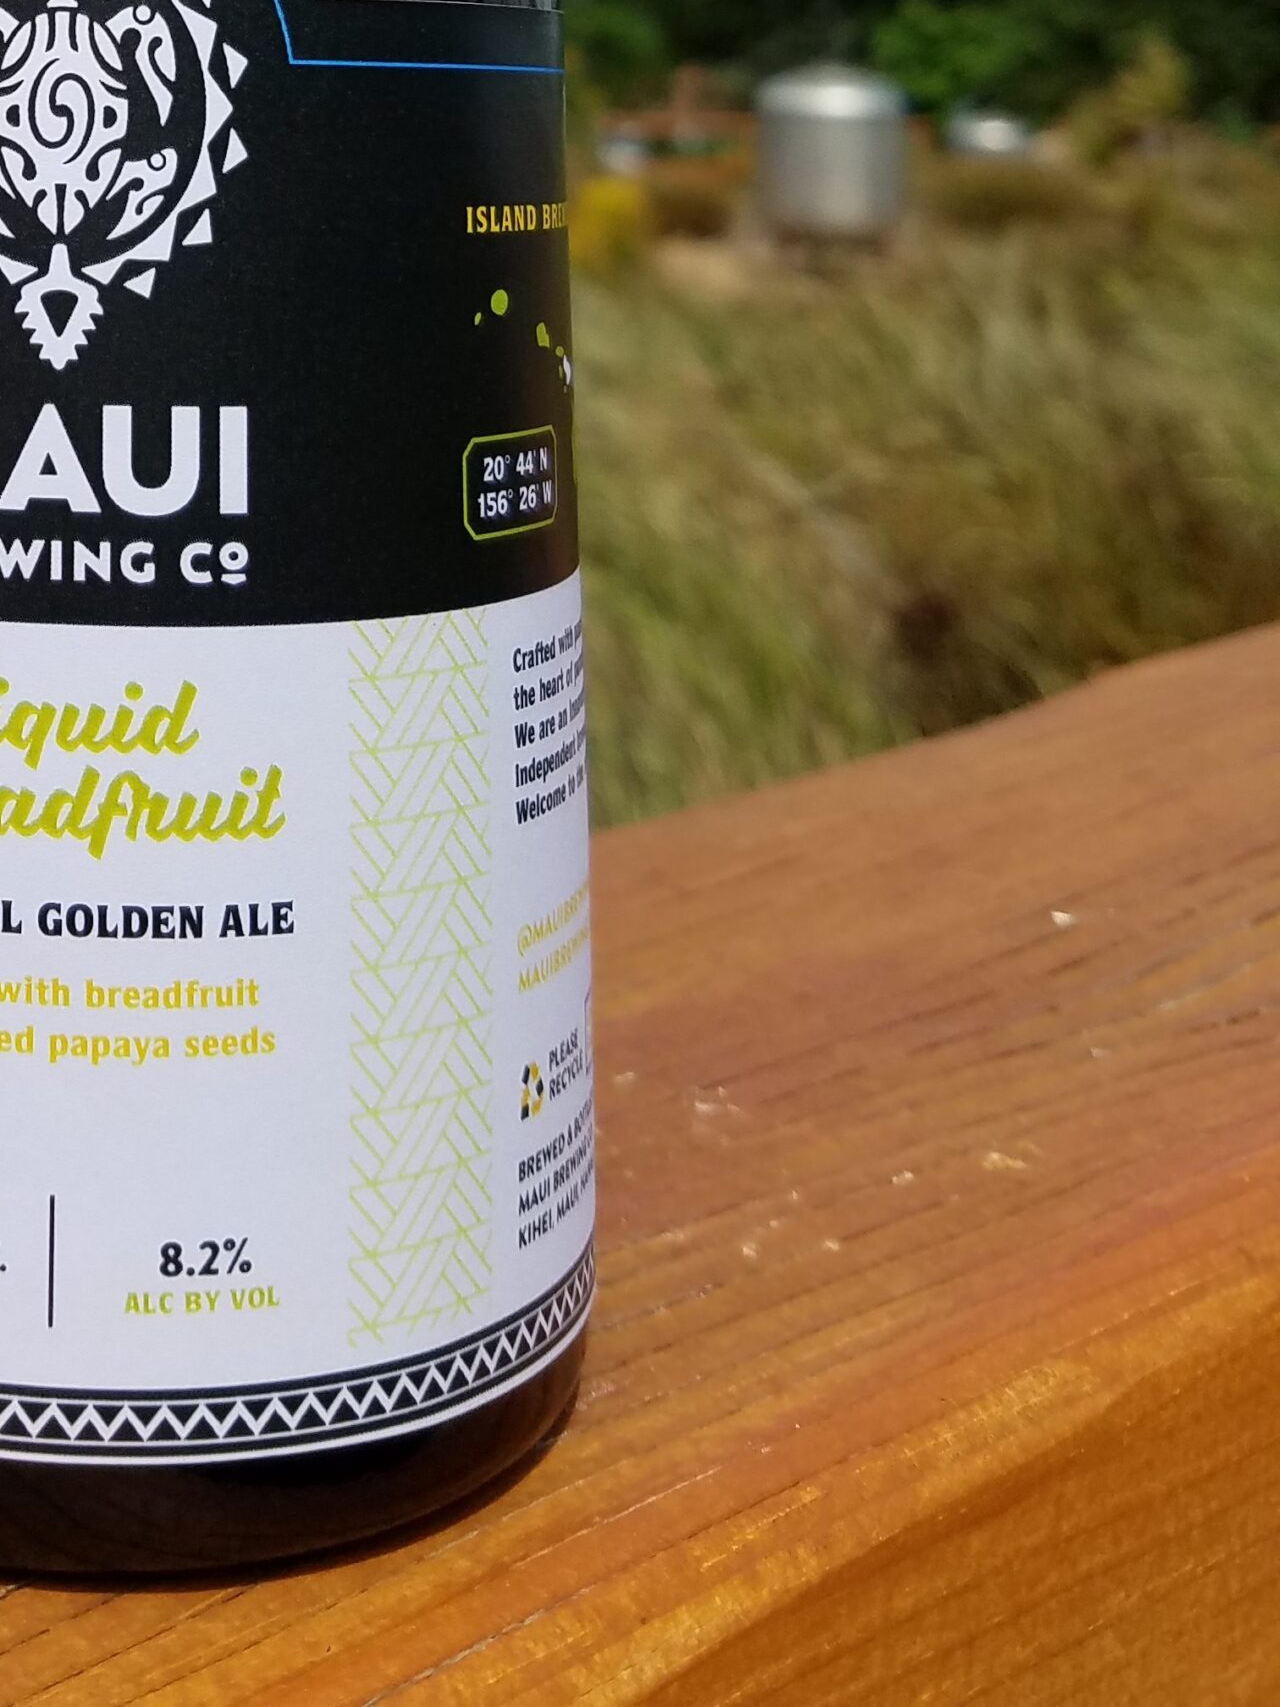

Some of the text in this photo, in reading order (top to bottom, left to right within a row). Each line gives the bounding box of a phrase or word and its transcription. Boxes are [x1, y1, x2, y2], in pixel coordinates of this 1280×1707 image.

[466, 202, 567, 233] ISLAND BRE
[539, 447, 548, 471] N
[542, 479, 552, 505] W
[513, 634, 556, 673] Crafted
[558, 626, 573, 654] with
[513, 684, 536, 711] the
[539, 668, 564, 702] heart
[566, 660, 573, 687] of
[514, 721, 536, 749] We
[539, 717, 555, 741] are
[558, 707, 568, 731] an
[515, 732, 576, 788] Independent
[515, 781, 566, 825] Welcome
[568, 773, 575, 797] to
[37, 902, 204, 940] GOLDEN
[219, 899, 295, 939] ALE
[85, 977, 260, 1010] breadfruit
[49, 1031, 170, 1066] papaya
[184, 1026, 276, 1059] seeds
[549, 1027, 579, 1073] PLEASE
[549, 1048, 583, 1101] RECYCLE
[518, 1132, 565, 1182] BREWED
[567, 1124, 573, 1147] &
[518, 1176, 550, 1216] MAUI
[553, 1135, 587, 1193] BREWING
[518, 1208, 554, 1250] KIHEI,
[159, 1237, 252, 1278] 8.2%
[124, 1285, 280, 1314] ALC BY VOL
